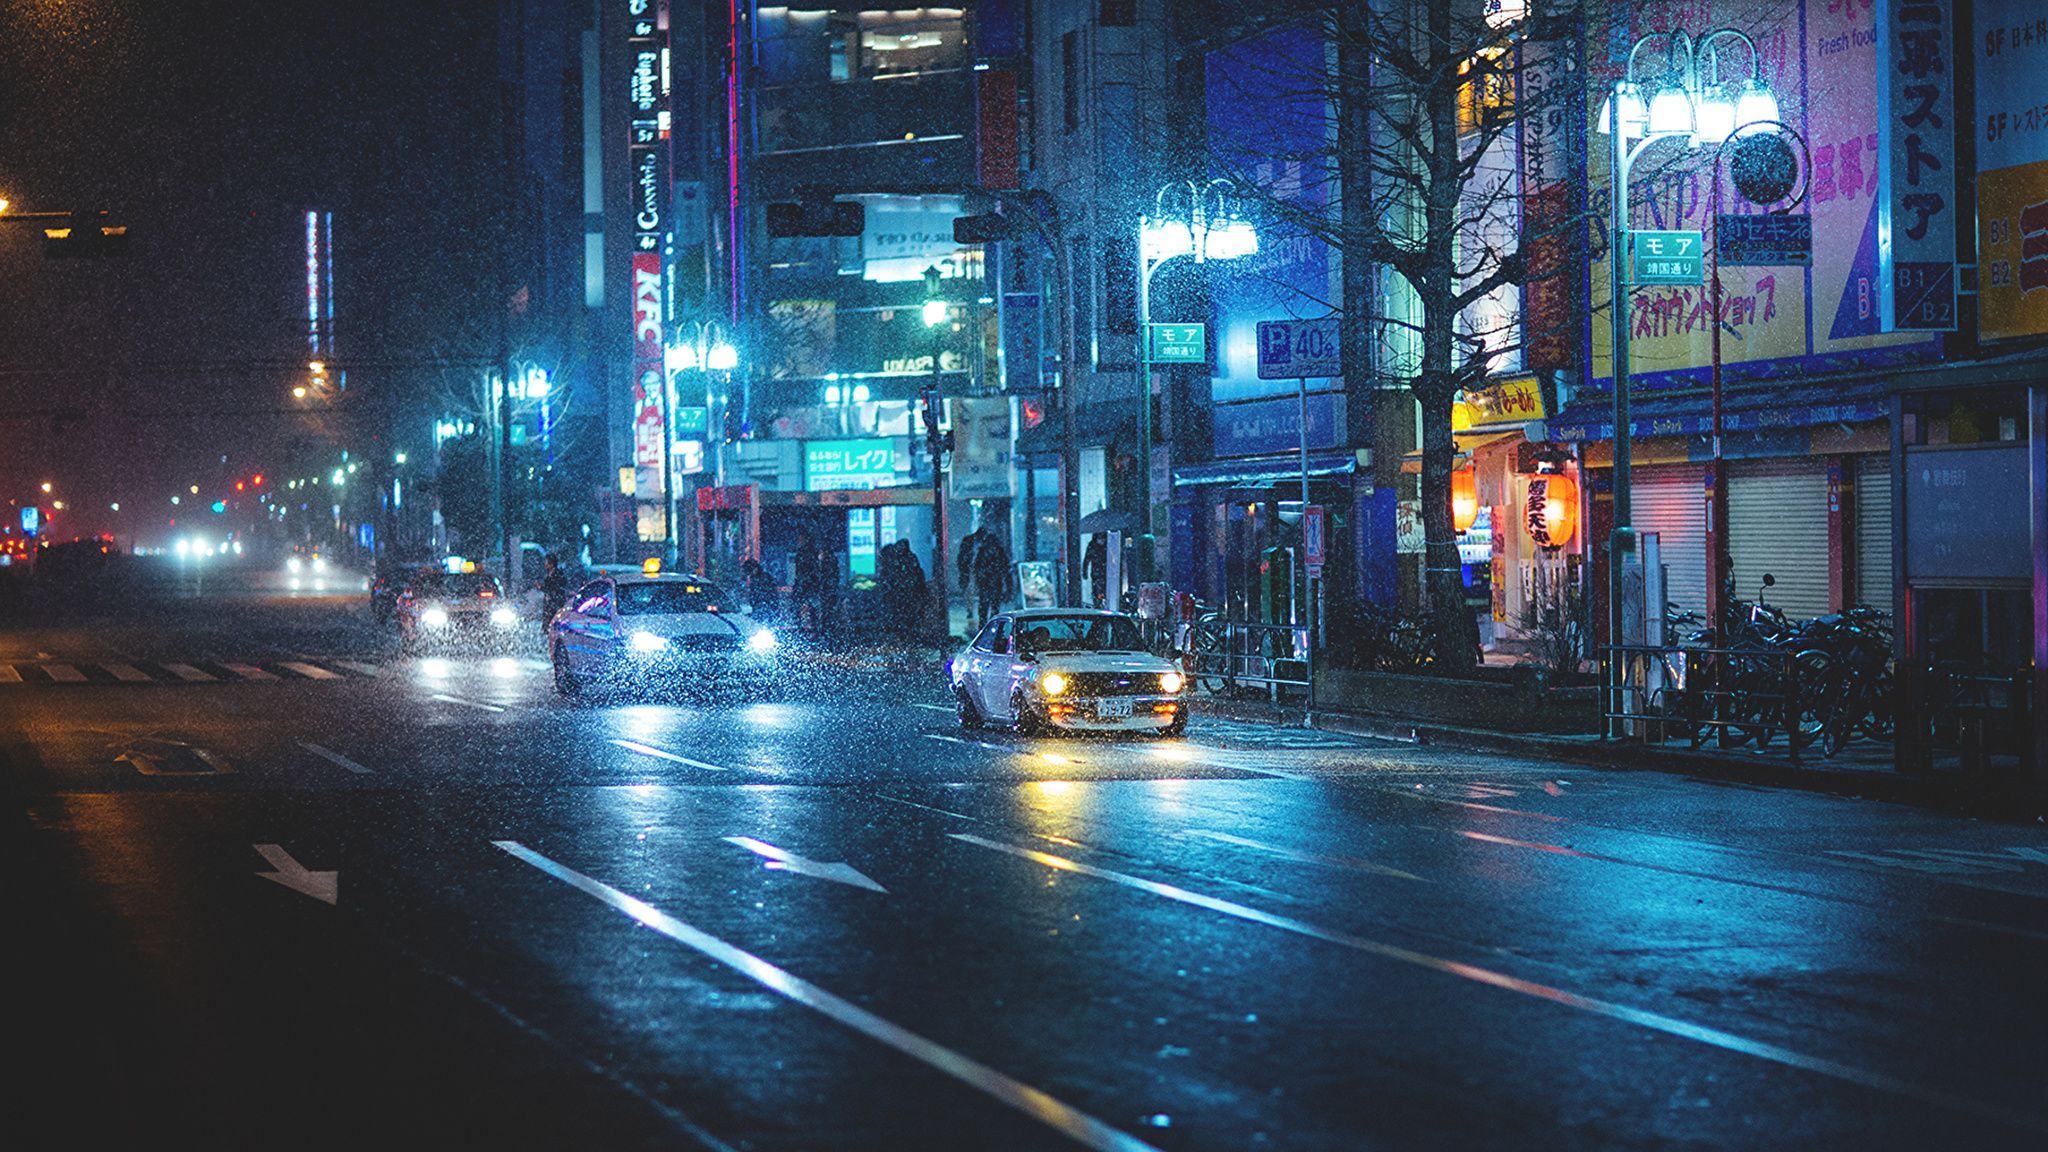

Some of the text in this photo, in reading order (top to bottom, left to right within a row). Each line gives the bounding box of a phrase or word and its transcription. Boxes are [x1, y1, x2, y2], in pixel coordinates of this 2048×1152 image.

[1818, 33, 1850, 57] Fresh
[1990, 217, 2009, 245] B1
[1646, 238, 1693, 256] モア
[1898, 268, 1925, 290] B1
[1991, 259, 2011, 286] B2
[635, 268, 662, 344] KFC
[1922, 302, 1951, 322] B2
[1162, 329, 1198, 342] モア
[1559, 426, 1586, 441] SunPark
[1652, 418, 1683, 434] SunPark
